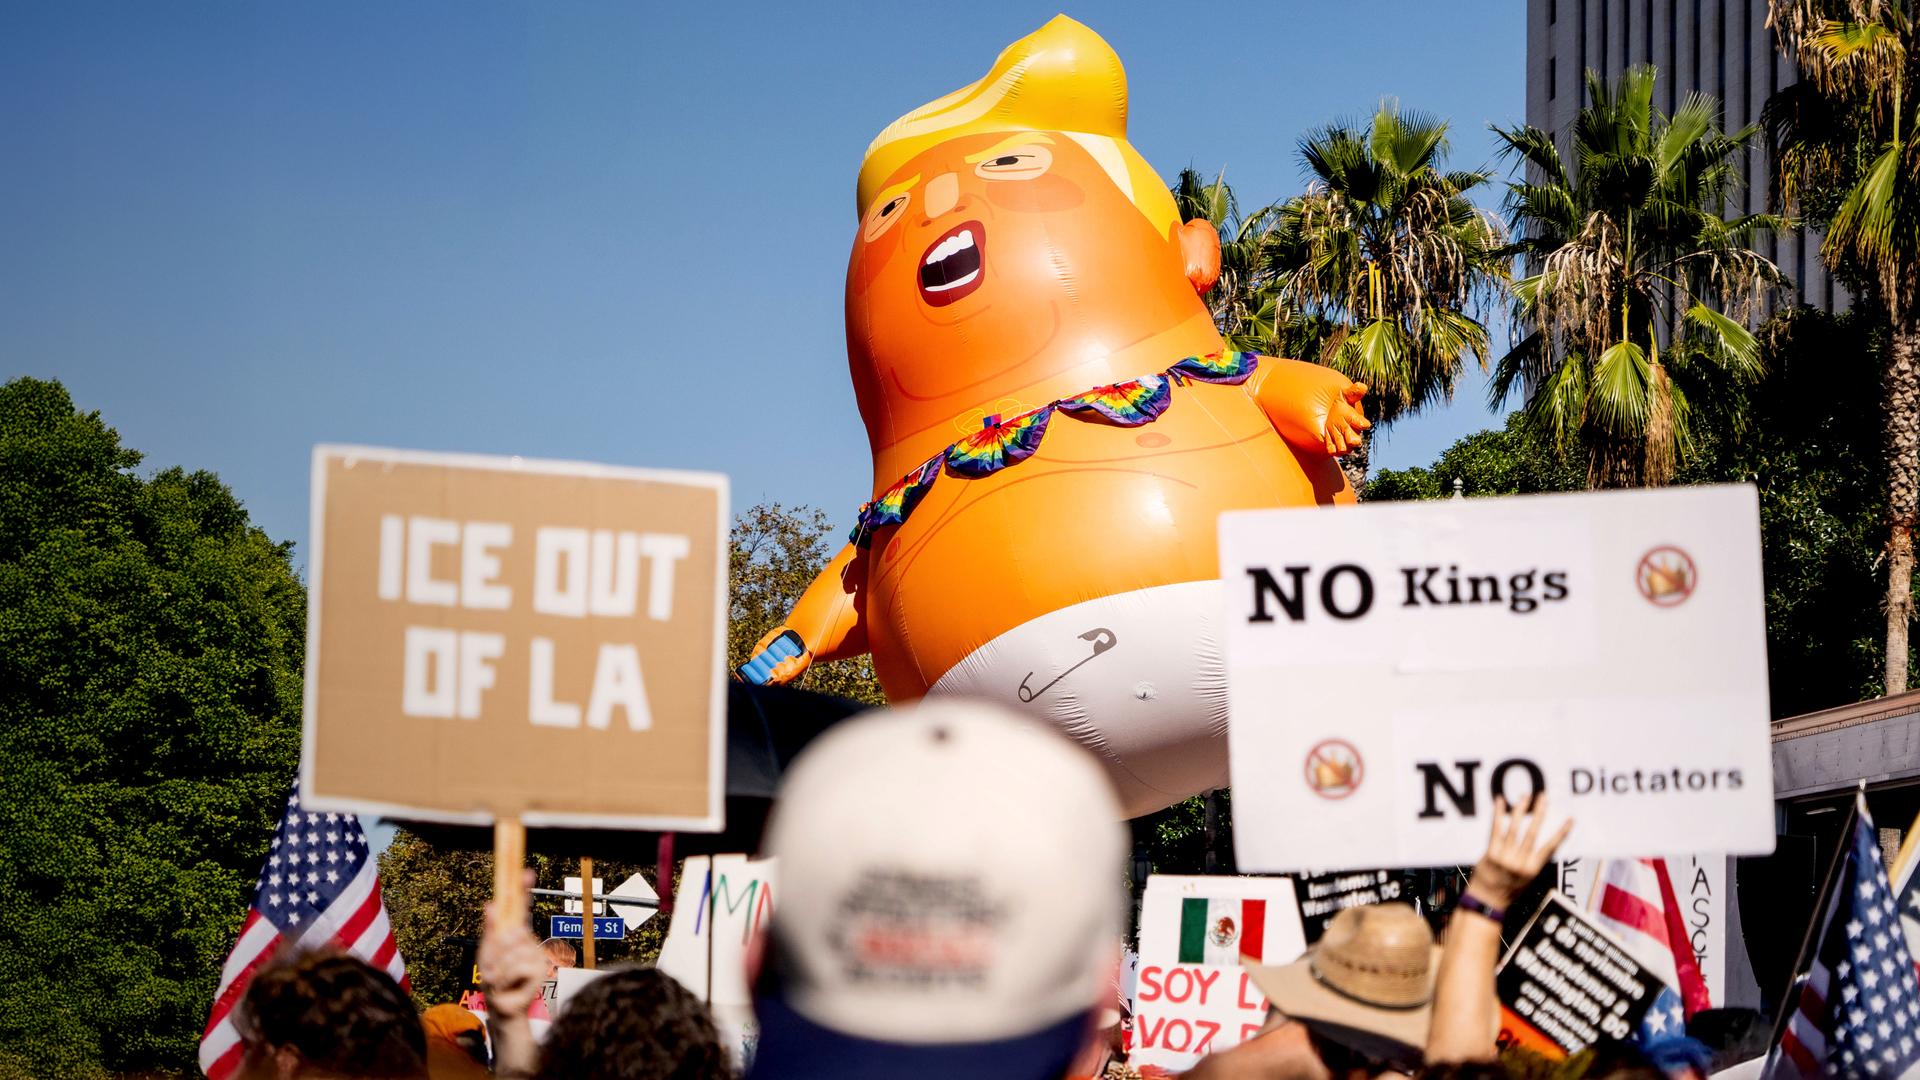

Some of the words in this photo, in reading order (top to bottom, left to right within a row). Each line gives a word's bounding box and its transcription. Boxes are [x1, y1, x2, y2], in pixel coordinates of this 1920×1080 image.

[378, 515, 513, 610] ICE
[533, 526, 690, 621] OUT
[1245, 563, 1375, 623] NO
[1400, 565, 1570, 614] Kings
[402, 626, 505, 720] OF
[529, 636, 652, 731] LA
[1415, 758, 1546, 819] NO
[1570, 767, 1744, 795] Dictators
[1380, 880, 1400, 900] DC
[558, 921, 599, 935] Teme
[605, 922, 618, 933] St
[1138, 966, 1221, 1006] SOY
[1514, 946, 1601, 1025] Washington,
[1601, 1012, 1630, 1040] DC
[1535, 937, 1617, 1007] Inundemos
[1612, 999, 1630, 1017] a
[1555, 926, 1577, 949] de
[1574, 940, 1645, 1000] noviembre
